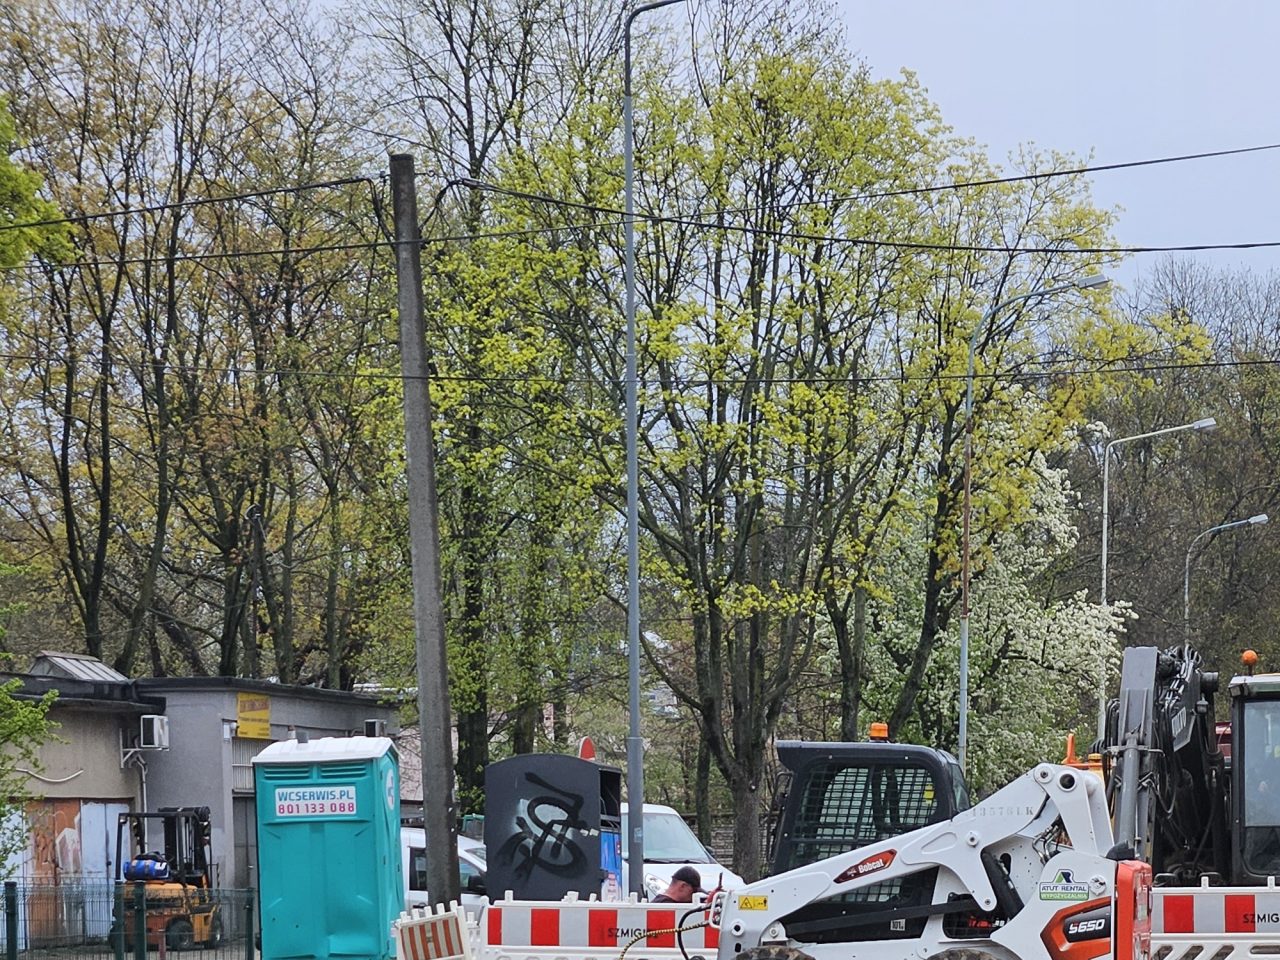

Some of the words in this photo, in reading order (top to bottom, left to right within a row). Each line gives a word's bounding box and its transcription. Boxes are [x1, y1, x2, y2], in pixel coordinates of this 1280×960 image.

[278, 790, 354, 801] WCSERWIS.PL
[278, 804, 300, 814] 801
[305, 803, 325, 813] 133
[330, 802, 355, 813] 088
[858, 859, 884, 874] Bobcat
[1068, 919, 1106, 934] S650
